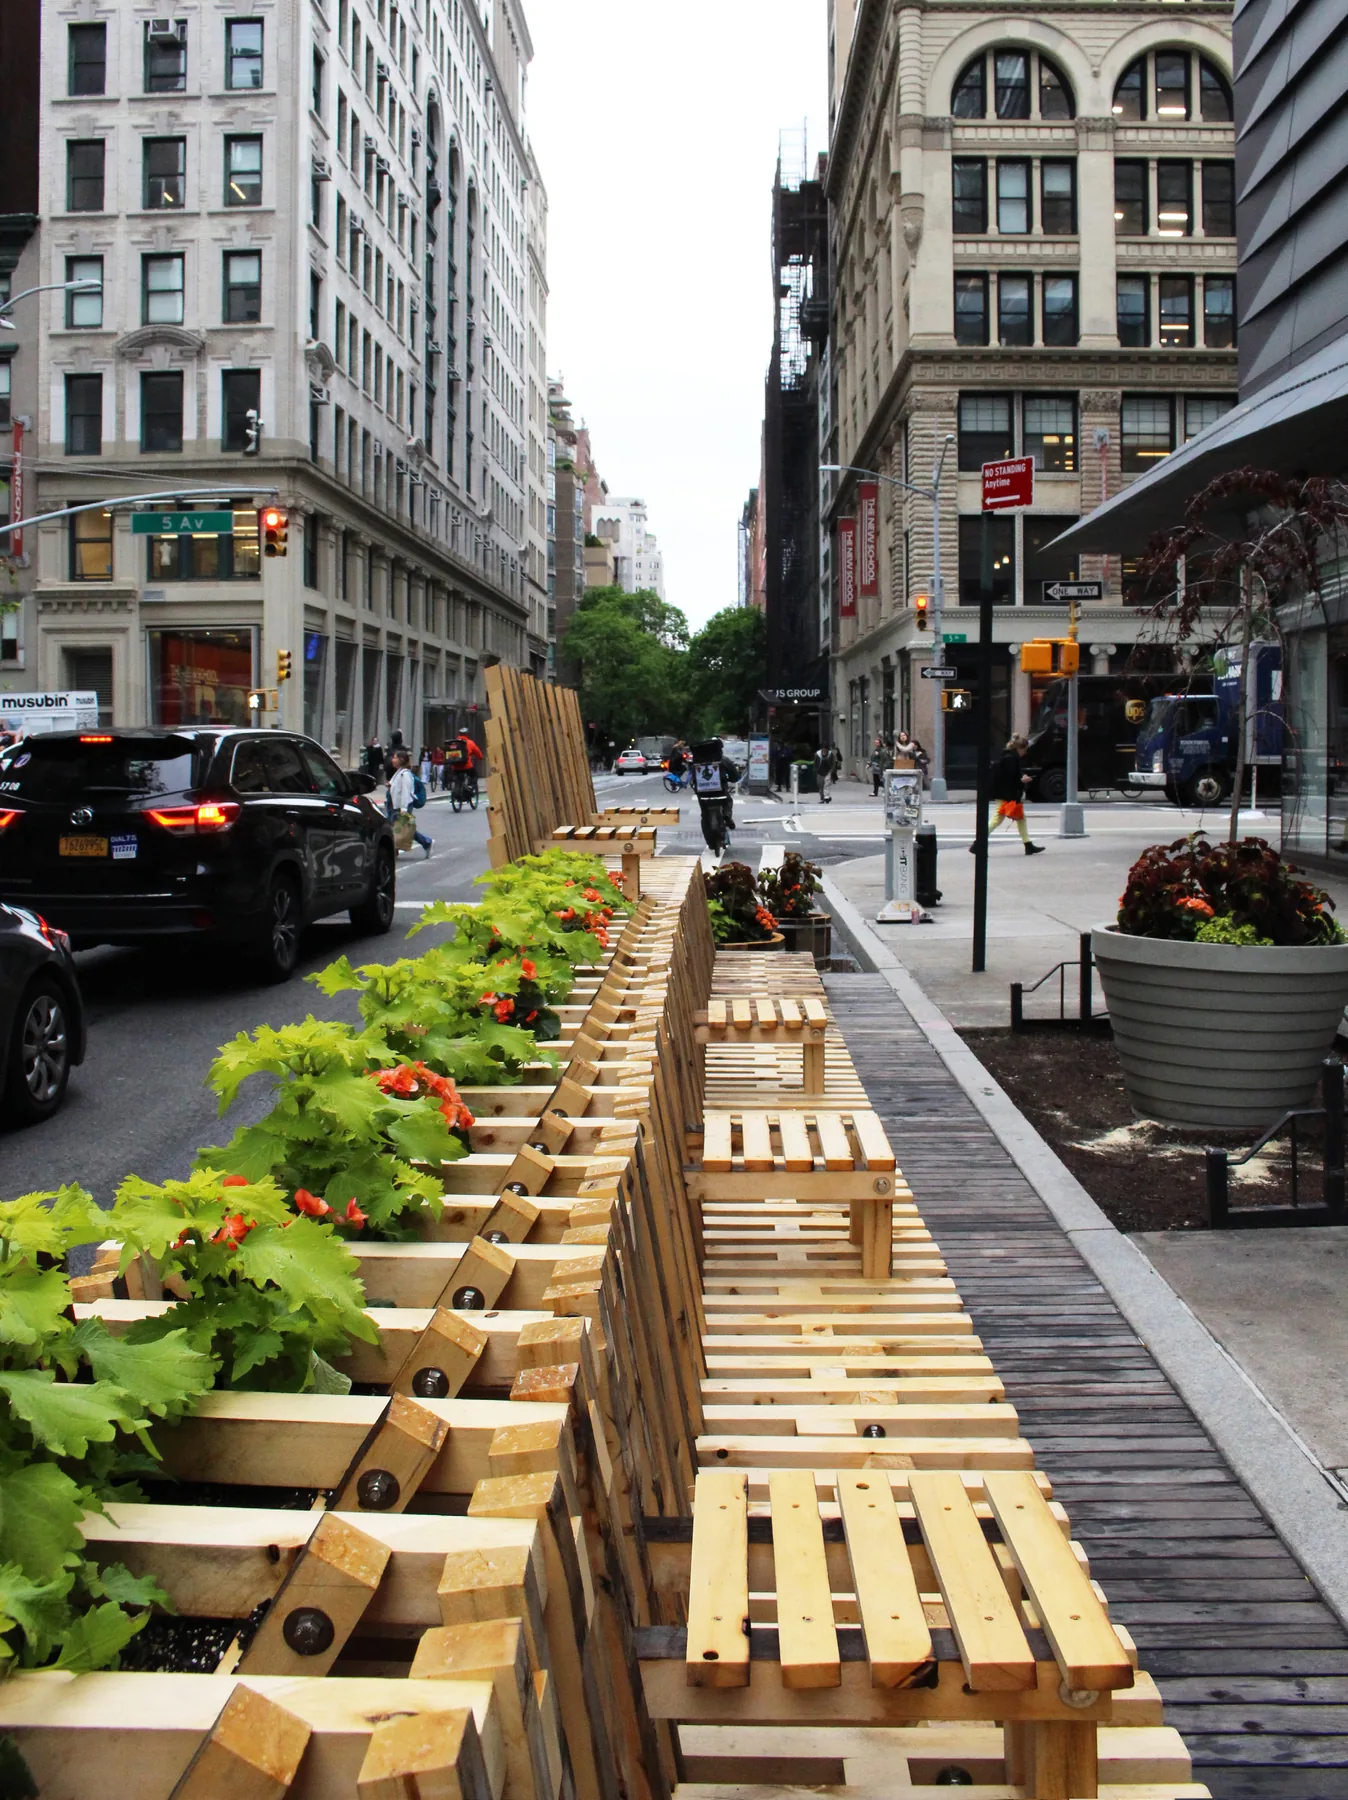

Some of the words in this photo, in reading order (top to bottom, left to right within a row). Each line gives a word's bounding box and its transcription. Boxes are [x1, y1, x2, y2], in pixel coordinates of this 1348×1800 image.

[985, 468, 994, 478] NO
[995, 463, 1026, 476] STANDING
[985, 478, 1010, 489] Anytime
[162, 516, 172, 530] 5
[180, 516, 204, 530] Av
[846, 547, 854, 570] NEW
[1052, 587, 1069, 596] ONE
[1076, 587, 1095, 596] WAY
[786, 688, 821, 698] GROUP
